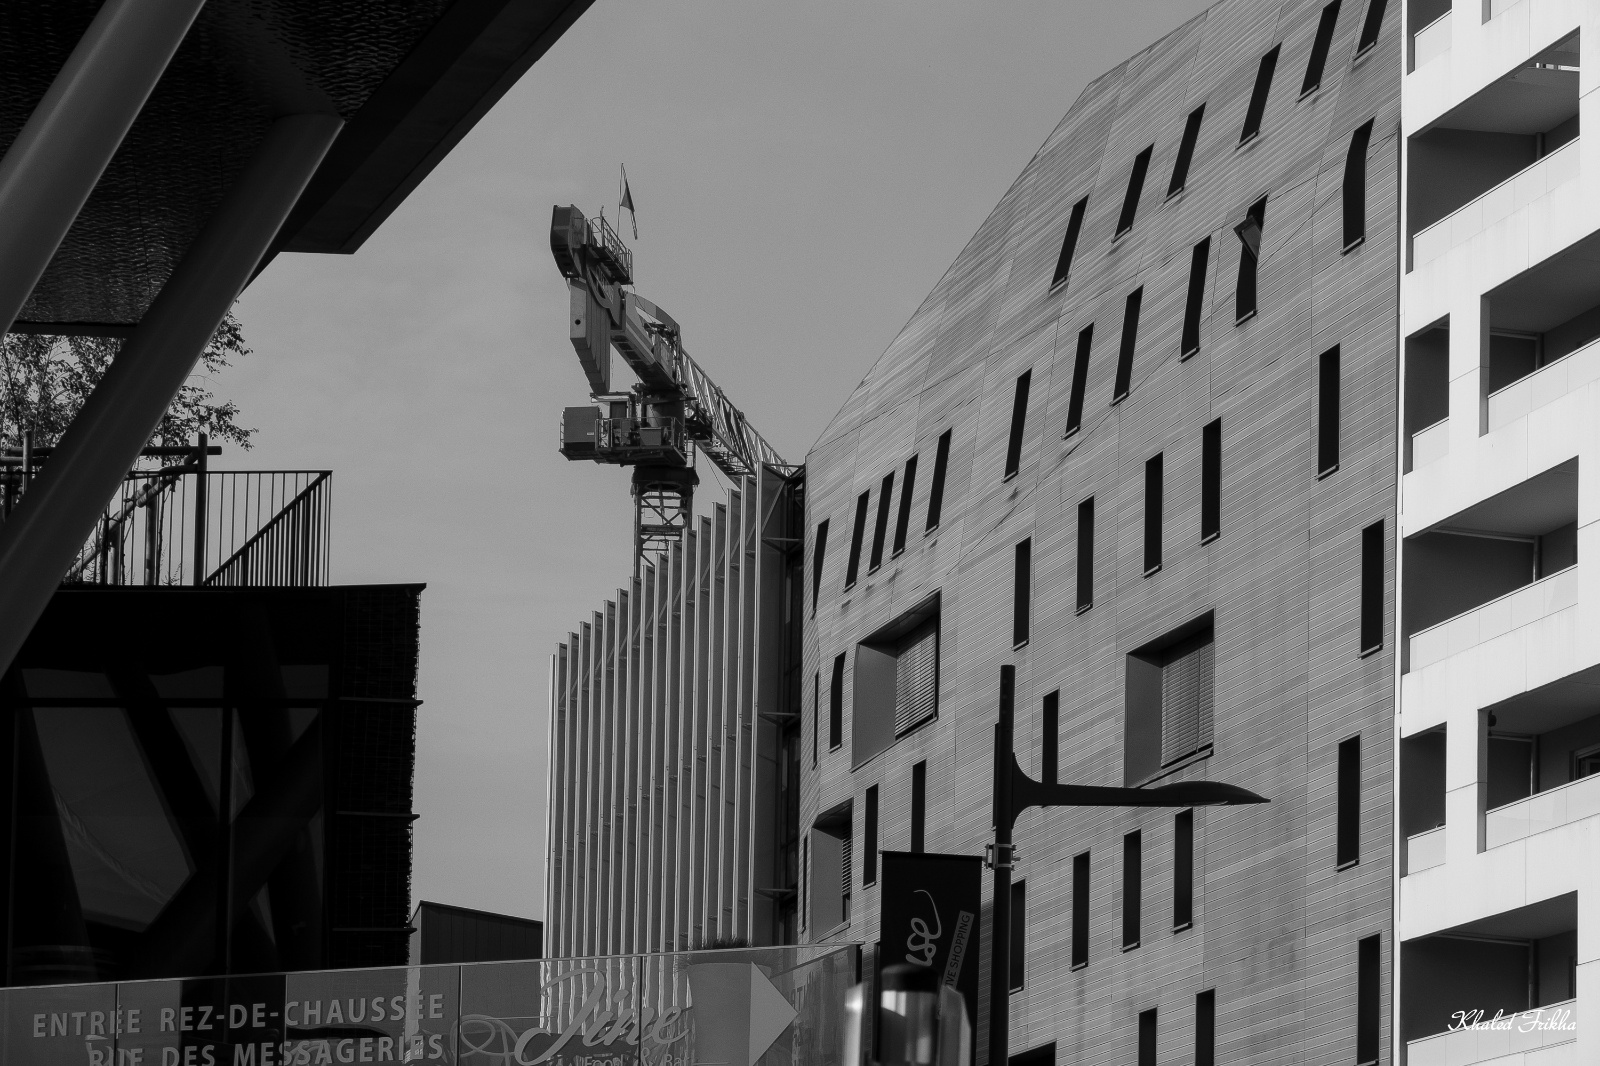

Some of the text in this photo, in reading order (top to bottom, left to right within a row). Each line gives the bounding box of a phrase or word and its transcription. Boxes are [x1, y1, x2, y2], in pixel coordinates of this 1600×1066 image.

[950, 914, 971, 969] SHOPPING
[33, 990, 444, 1038] ENTRÉE REZ-DE-CHAUSSÉE
[161, 1045, 216, 1066] DES
[233, 1033, 443, 1066] MESSAGERIES
